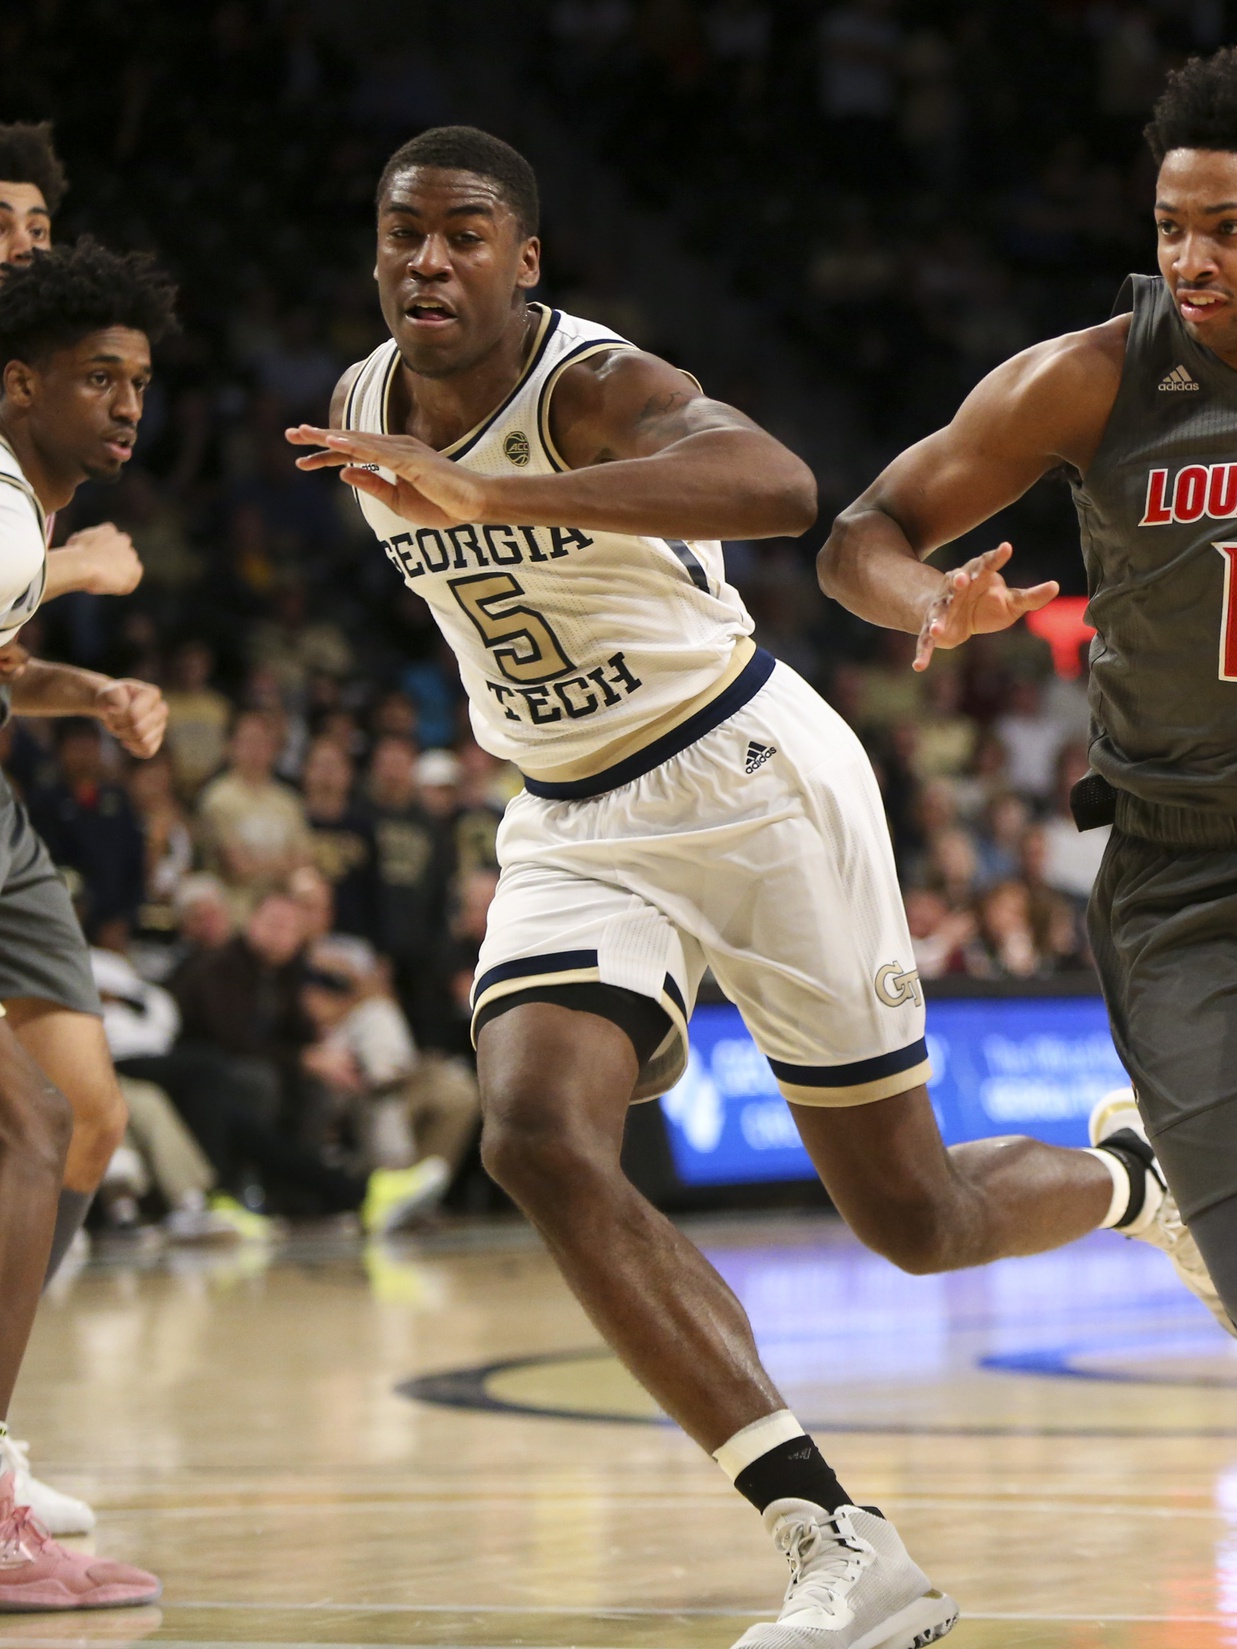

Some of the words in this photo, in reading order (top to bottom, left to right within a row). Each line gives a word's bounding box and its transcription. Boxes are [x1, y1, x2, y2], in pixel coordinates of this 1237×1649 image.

[1158, 381, 1199, 391] adidas
[509, 442, 528, 451] ACC
[446, 572, 577, 684] 5
[486, 652, 643, 725] TECH
[745, 746, 777, 774] adidas
